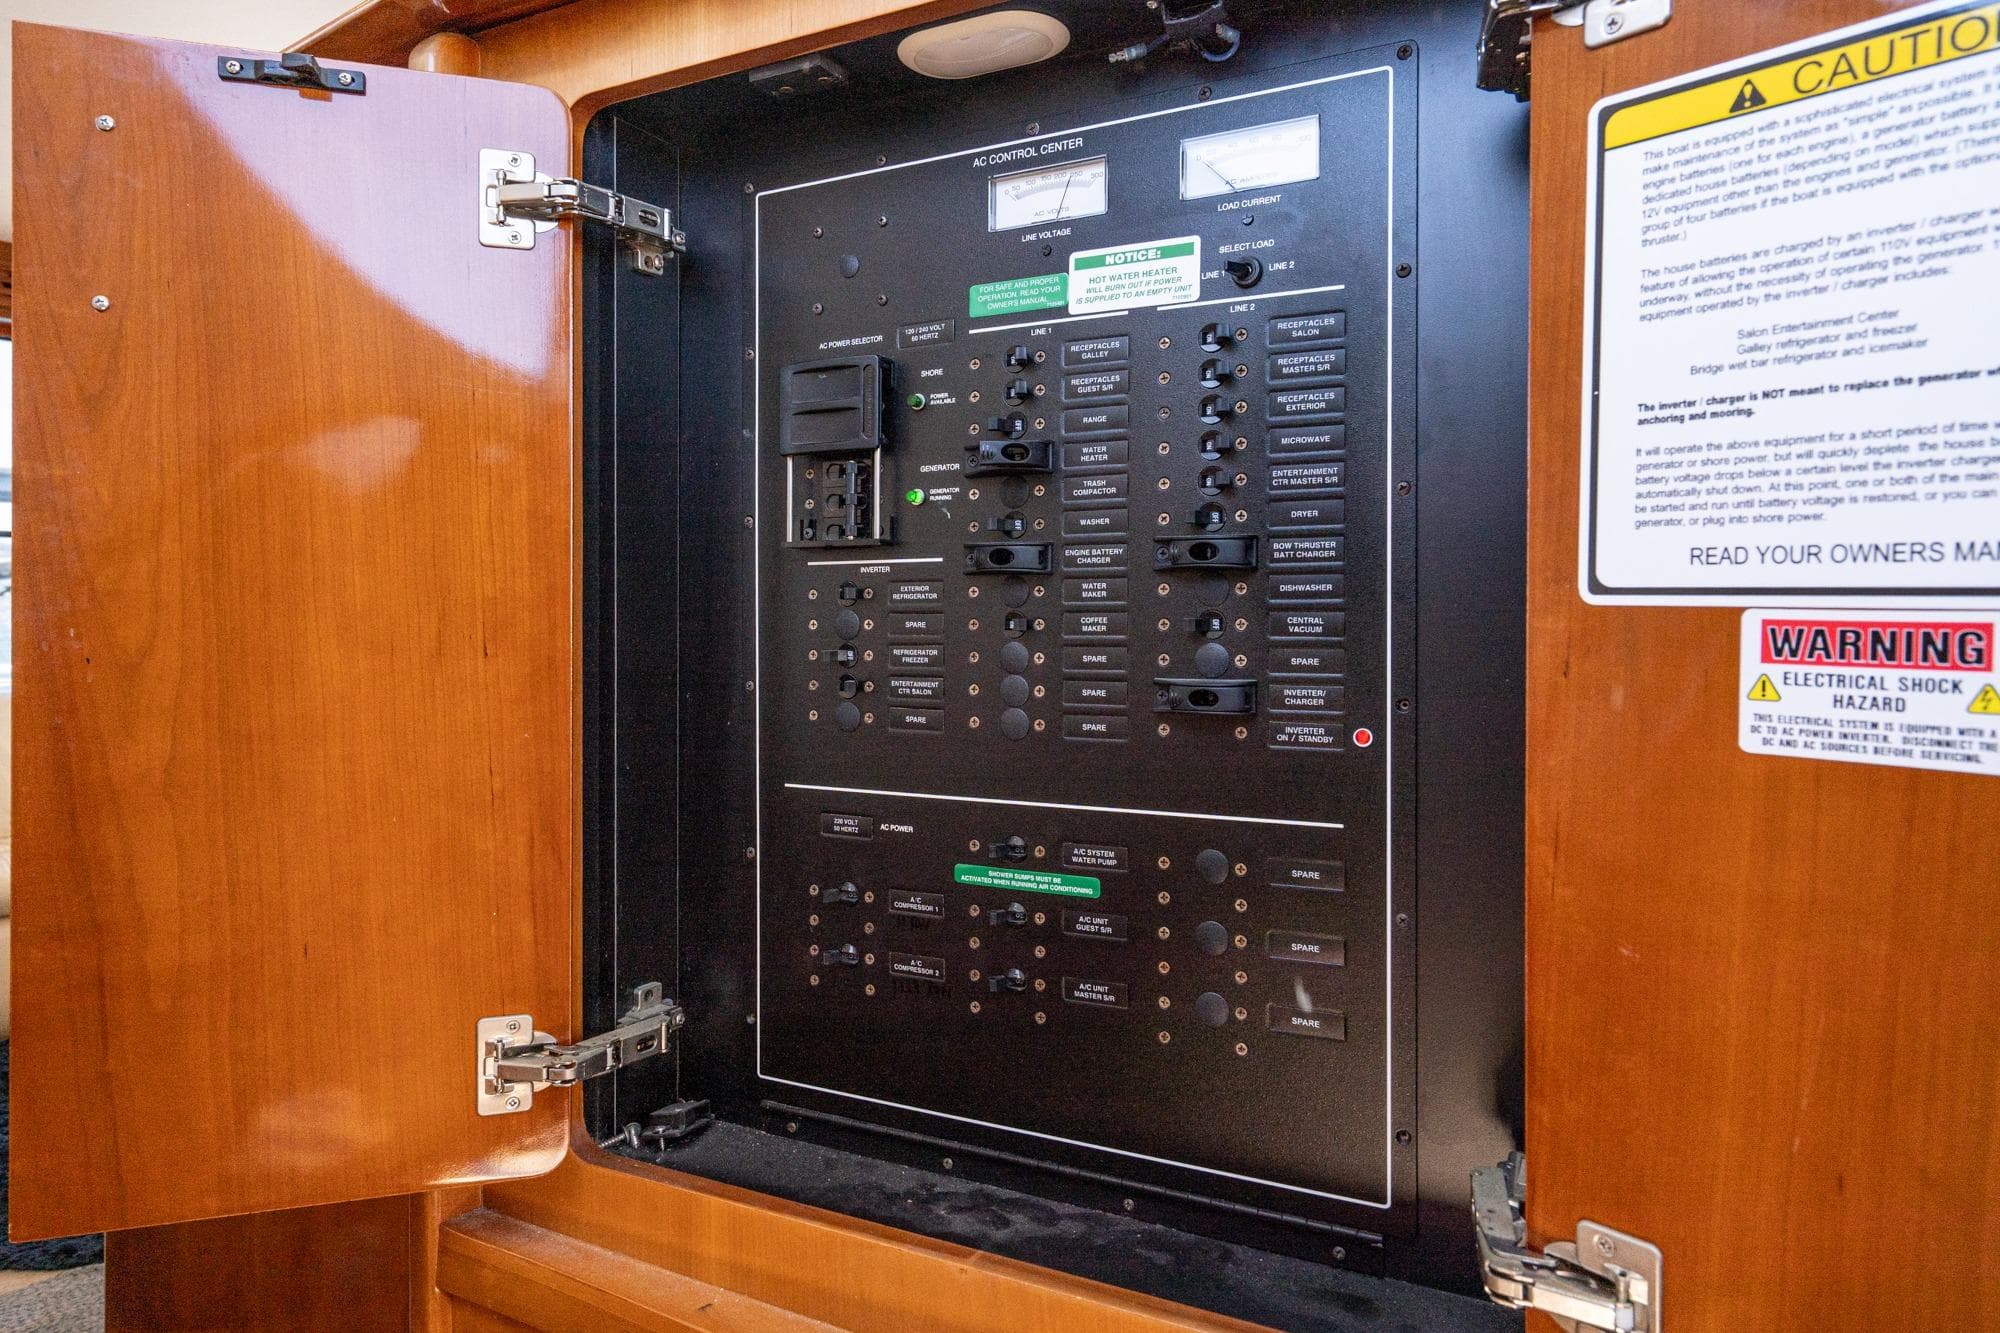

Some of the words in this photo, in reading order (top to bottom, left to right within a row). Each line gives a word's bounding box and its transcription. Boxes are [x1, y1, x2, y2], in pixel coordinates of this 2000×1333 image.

[1794, 9, 2000, 94] CAUTIO
[973, 156, 987, 167] AC
[989, 146, 1038, 164] CONTROL
[1040, 137, 1084, 156] CENTER
[1218, 201, 1240, 211] LOAD
[1241, 195, 1281, 209] CURRENT
[1022, 234, 1037, 242] LINE
[1038, 228, 1071, 240] VOLTAGE
[1219, 242, 1249, 254] SELECT
[1251, 239, 1275, 249] LOAD
[1105, 249, 1161, 266] NOTICE:
[1269, 262, 1286, 272] LINE
[1288, 261, 1295, 270] 2
[1089, 274, 1106, 284] HOT
[1108, 270, 1140, 282] WATER
[1143, 267, 1177, 278] HEATER
[1202, 270, 1219, 280] LINE
[1221, 270, 1225, 278] 1
[979, 285, 994, 293] FOR
[995, 282, 1013, 291] SAFE
[1014, 280, 1029, 288] AND
[1030, 276, 1059, 287] PROPER
[1086, 285, 1105, 294] WILL
[1106, 282, 1125, 292] BURN
[1128, 280, 1142, 290] OUT
[1145, 280, 1152, 288] IF
[1153, 276, 1182, 287] POWER
[1022, 289, 1039, 297] READ
[1041, 285, 1061, 294] YOUR
[1076, 296, 1084, 305] IS
[1085, 292, 1117, 303] SUPPLIED
[1118, 291, 1129, 300] TO
[1131, 290, 1142, 298] AN
[1144, 286, 1171, 297] EMPTY
[1172, 284, 1192, 294] UNIT
[1277, 318, 1335, 330] RECEPTACLES
[1738, 328, 1769, 339] Salon
[1858, 310, 1899, 323] Center
[1292, 329, 1319, 337] SALON
[820, 340, 827, 349] AC
[829, 338, 850, 348] POWER
[851, 335, 883, 346] SELECTOR
[1071, 342, 1120, 352] RECEPTACLES
[1082, 351, 1108, 359] GALLEY
[1278, 355, 1335, 365] RECEPTACLES
[921, 369, 943, 377] SHORE
[1282, 365, 1314, 373] MASTER
[1071, 375, 1120, 385] RECEPTACLES
[1078, 385, 1101, 393] GUEST
[1638, 403, 1655, 412] The
[1659, 400, 1696, 410] inverter
[1706, 394, 1746, 406] charger
[1750, 392, 1758, 400] is
[1762, 389, 1785, 398] NOT
[1789, 386, 1824, 397] meant
[1829, 384, 1839, 392] to
[1844, 379, 1889, 392] replace
[1894, 377, 1913, 386] the
[1918, 370, 1981, 386] generator
[1277, 392, 1335, 403] RECEPTACLES
[1286, 402, 1325, 411] EXTERIOR
[1638, 413, 1685, 425] anchoring
[1689, 411, 1706, 420] and
[1281, 435, 1330, 444] MICROWAVE
[1081, 454, 1108, 462] HEATER
[920, 464, 960, 472] GENERATOR
[1272, 468, 1338, 477] ENTERTAINMENT
[1290, 477, 1323, 486] MASTER
[1073, 488, 1116, 496] COMPACTOR
[1291, 510, 1318, 518] DRYER
[1296, 550, 1336, 558] CHARGER
[1690, 546, 1748, 565] READ
[1756, 545, 1822, 564] YOUR
[1830, 542, 1945, 563] OWNERS
[1280, 584, 1332, 592] DISHWASHER
[1770, 627, 1984, 664] WARNING
[1784, 672, 1888, 690] ELECTRICAL
[1898, 677, 1963, 694] SHOCK
[1284, 689, 1326, 697] INVERTER/
[1833, 695, 1906, 712] HAZARD
[1298, 735, 1333, 743] STANDBY
[890, 824, 913, 833] POWER
[1072, 856, 1096, 864] WATER
[1292, 870, 1320, 879] SPARE
[894, 902, 933, 912] COMPRESSOR
[1076, 924, 1099, 932] GUEST
[1291, 944, 1319, 953] SPARE
[894, 964, 934, 975] COMPRESSOR
[1093, 985, 1109, 993] UNIT
[1074, 991, 1102, 1000] MASTER
[1292, 1017, 1320, 1028] SPARE
